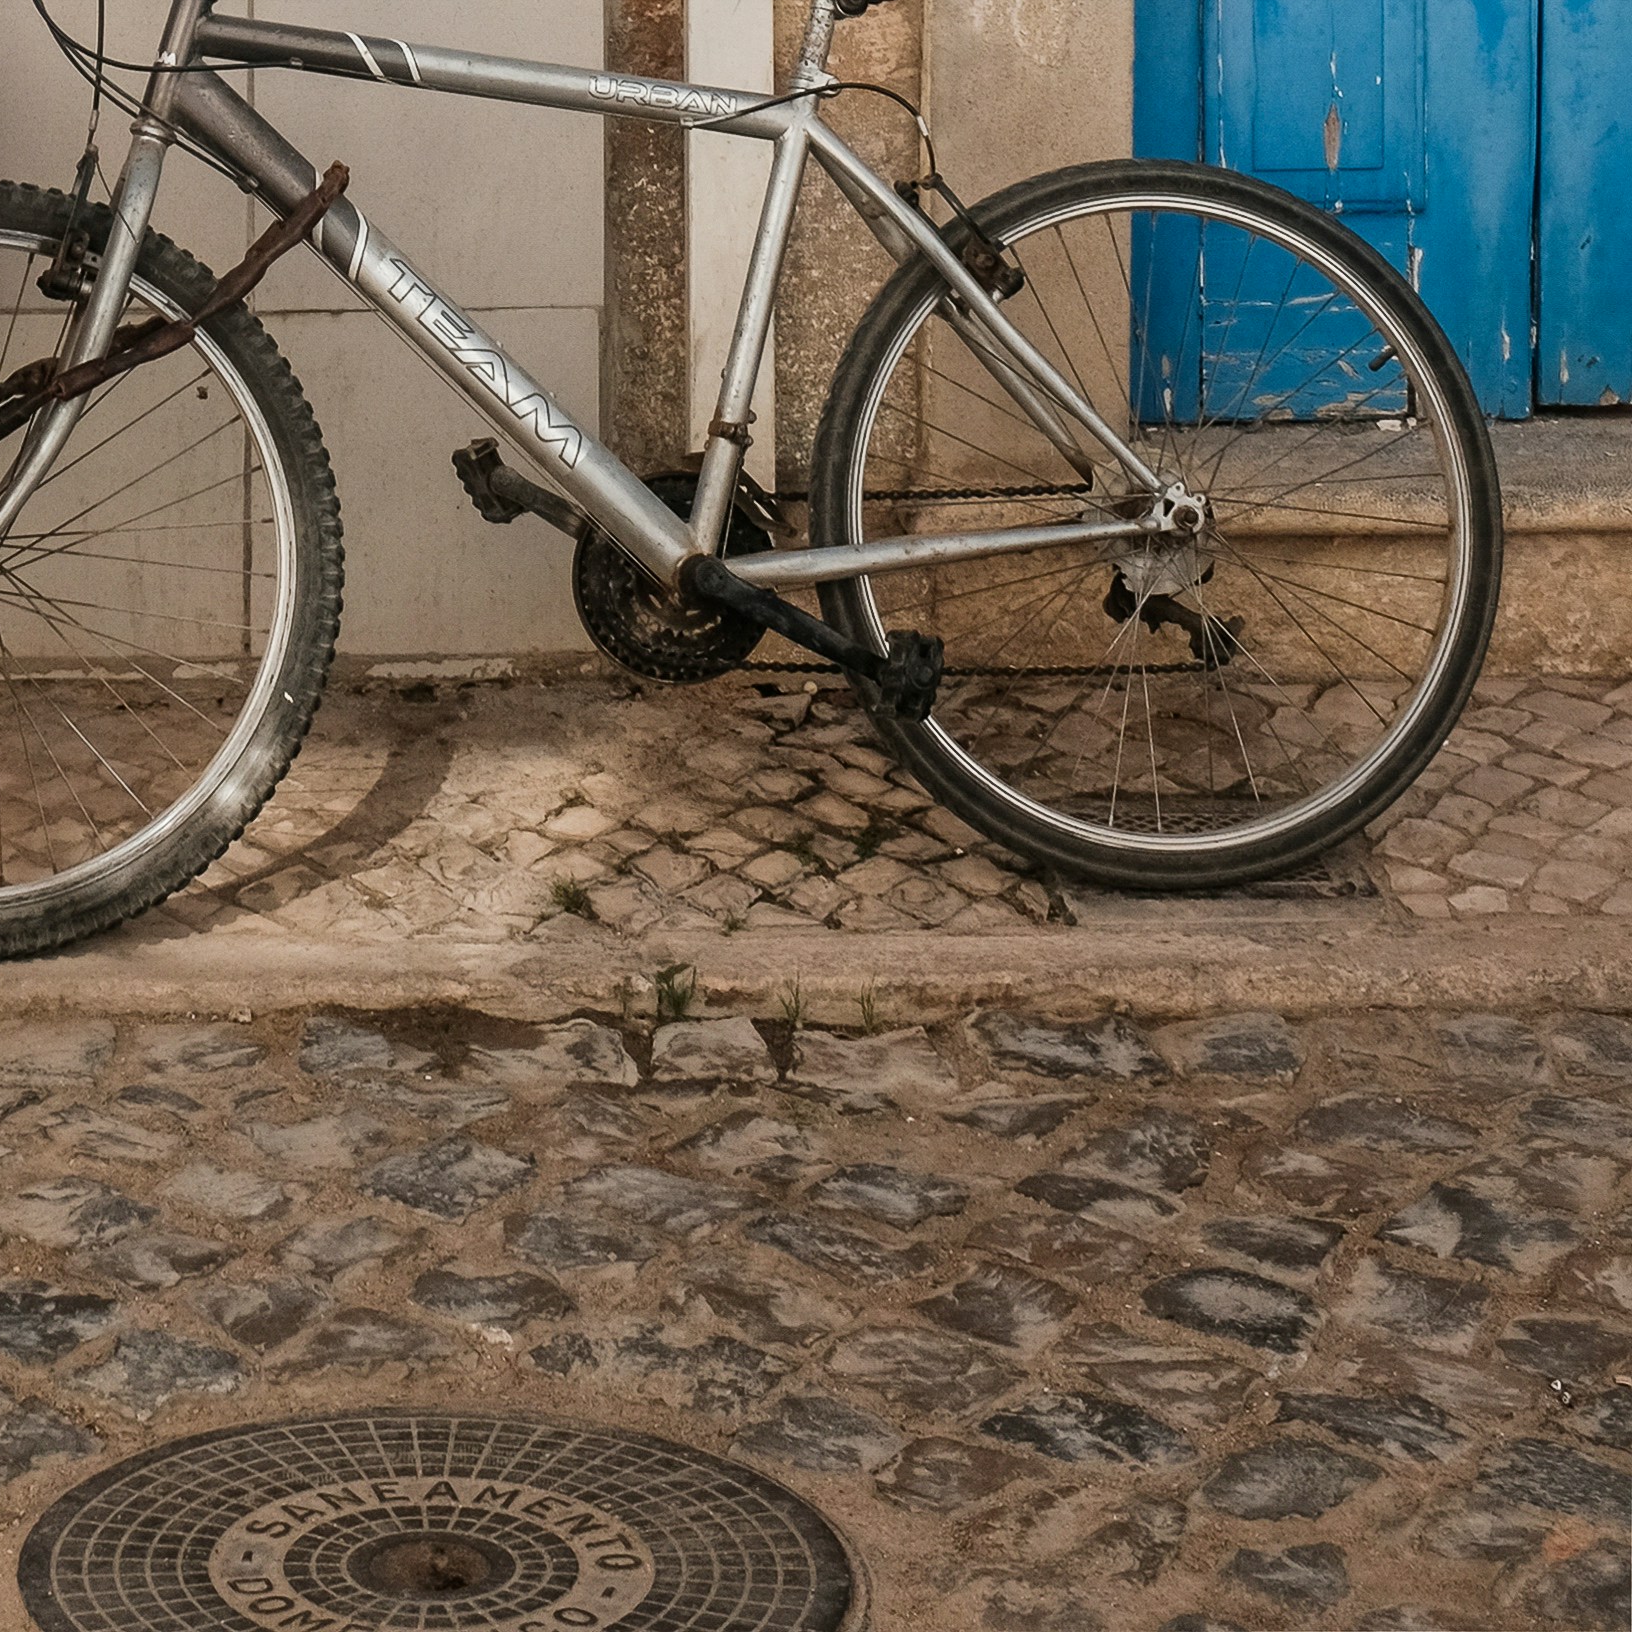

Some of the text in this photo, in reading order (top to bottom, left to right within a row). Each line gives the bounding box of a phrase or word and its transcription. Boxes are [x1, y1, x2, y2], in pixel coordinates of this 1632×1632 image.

[588, 75, 738, 116] URBAN
[387, 257, 583, 470] TEAM
[246, 1479, 643, 1573] SANEAMENTO
